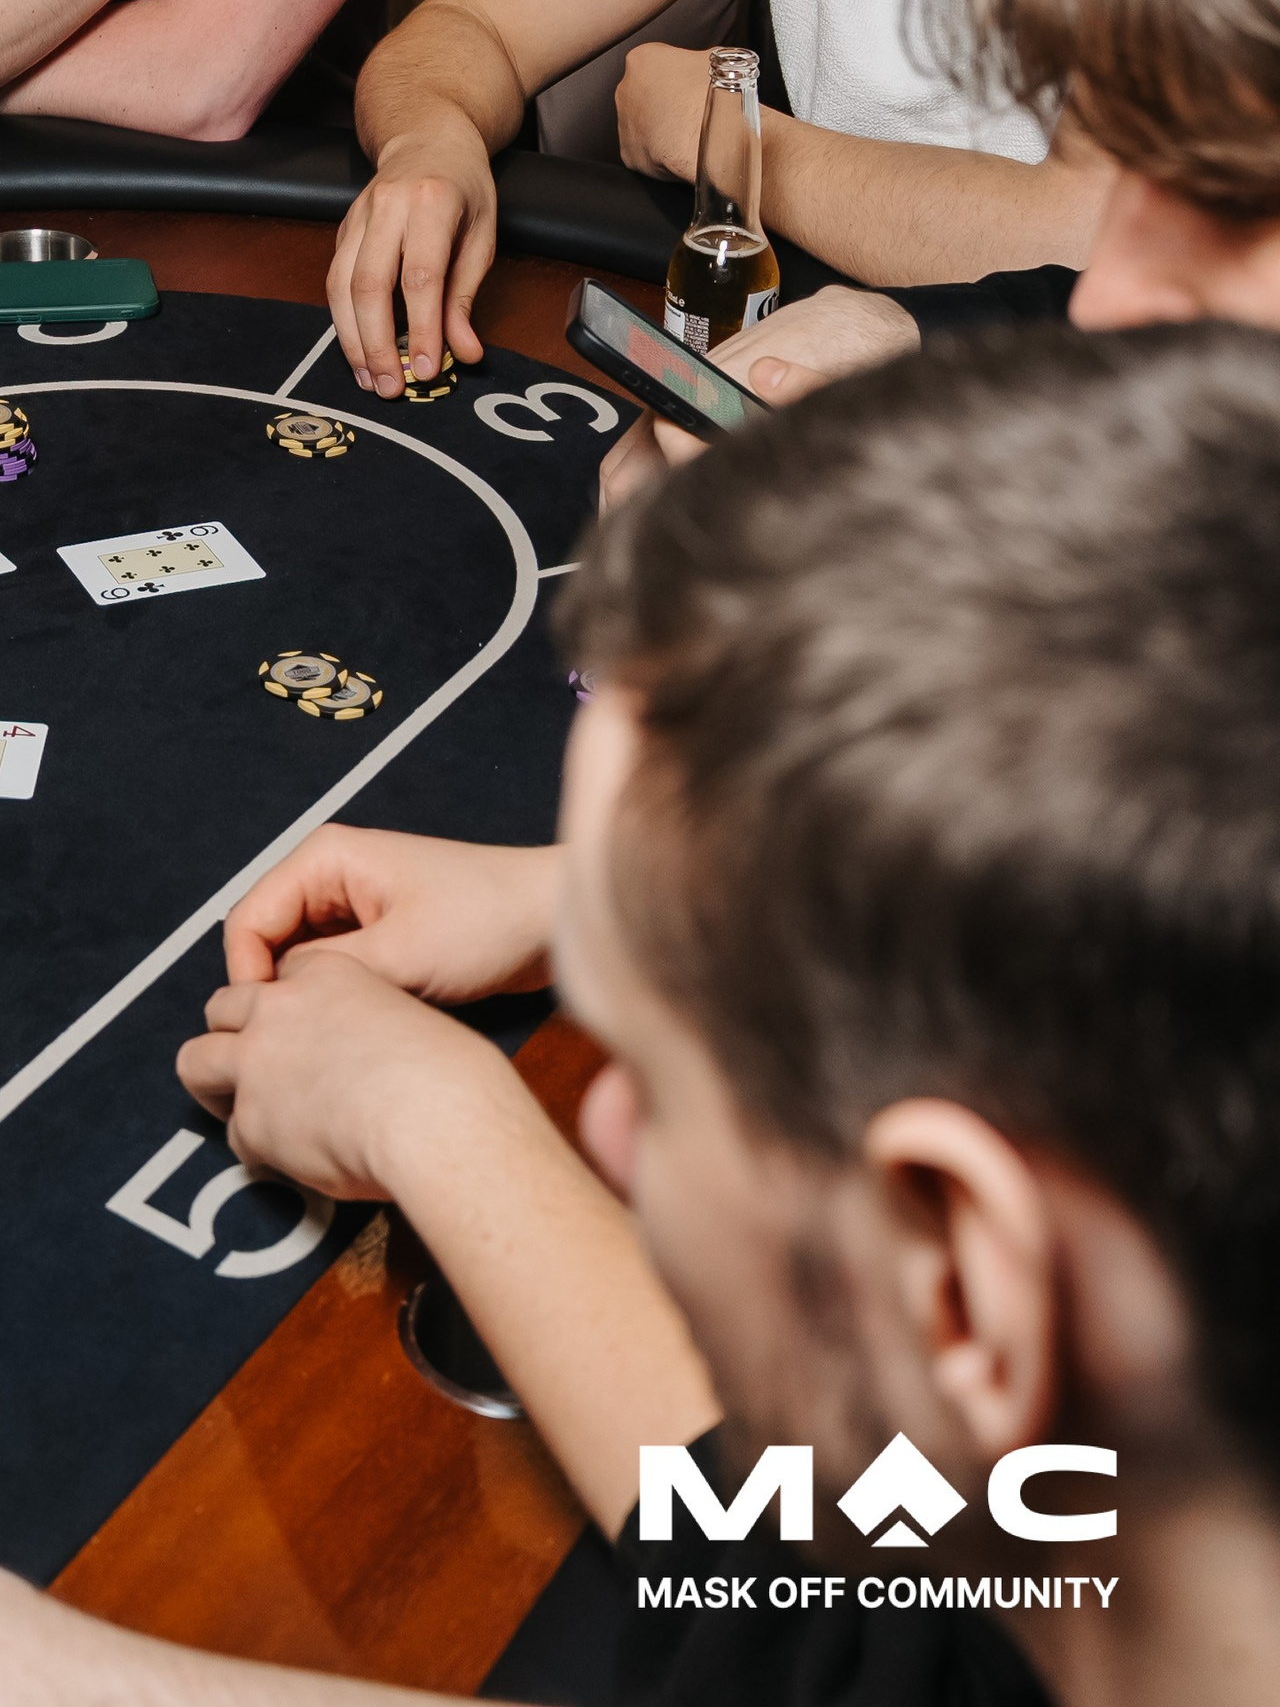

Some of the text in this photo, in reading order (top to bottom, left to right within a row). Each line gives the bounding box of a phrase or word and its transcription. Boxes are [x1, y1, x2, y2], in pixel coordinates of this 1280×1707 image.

[473, 382, 619, 442] 3
[3, 725, 36, 738] 4
[105, 1128, 336, 1279] 5
